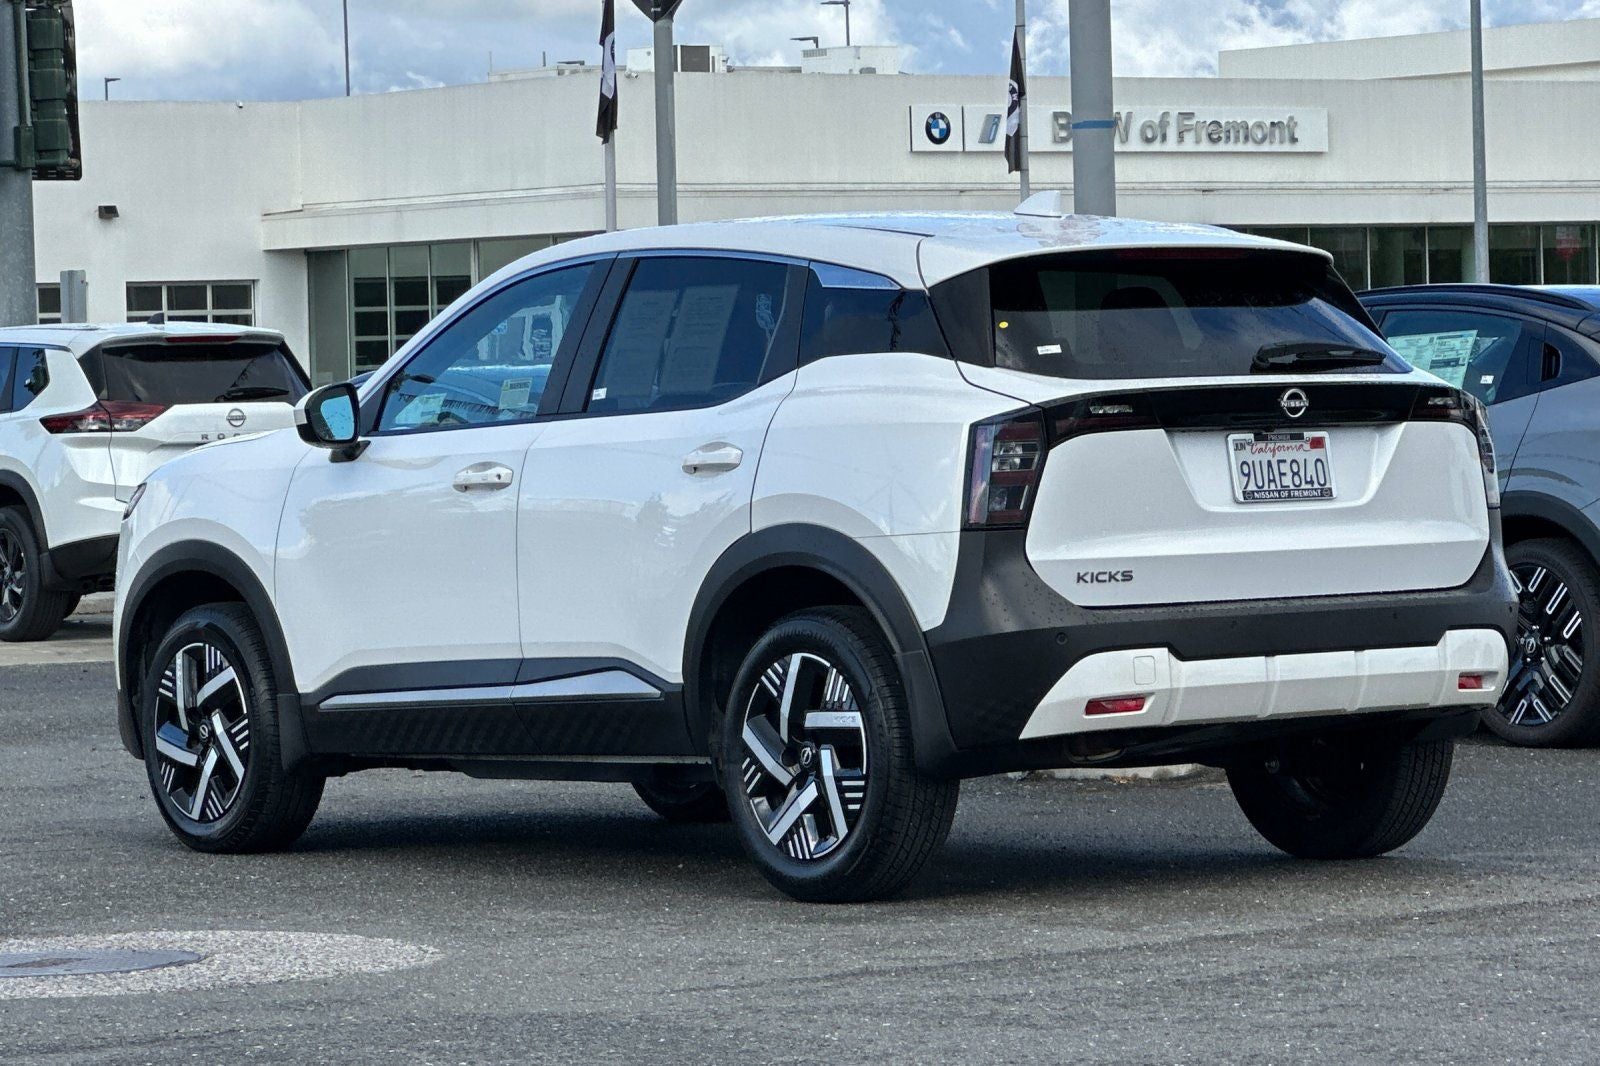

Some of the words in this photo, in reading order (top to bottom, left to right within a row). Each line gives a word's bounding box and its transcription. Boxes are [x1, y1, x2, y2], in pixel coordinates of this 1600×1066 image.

[1052, 111, 1133, 143] BW
[1140, 111, 1170, 144] of
[1177, 111, 1298, 144] Fremont
[1280, 399, 1309, 407] NISSAN
[1234, 440, 1246, 451] JUN
[1250, 442, 1311, 458] California
[1240, 458, 1327, 490] 9UAE840
[1254, 490, 1279, 499] NISSAN
[1280, 490, 1289, 498] OF
[1290, 489, 1321, 498] FREMONT
[1076, 570, 1134, 584] KICKS
